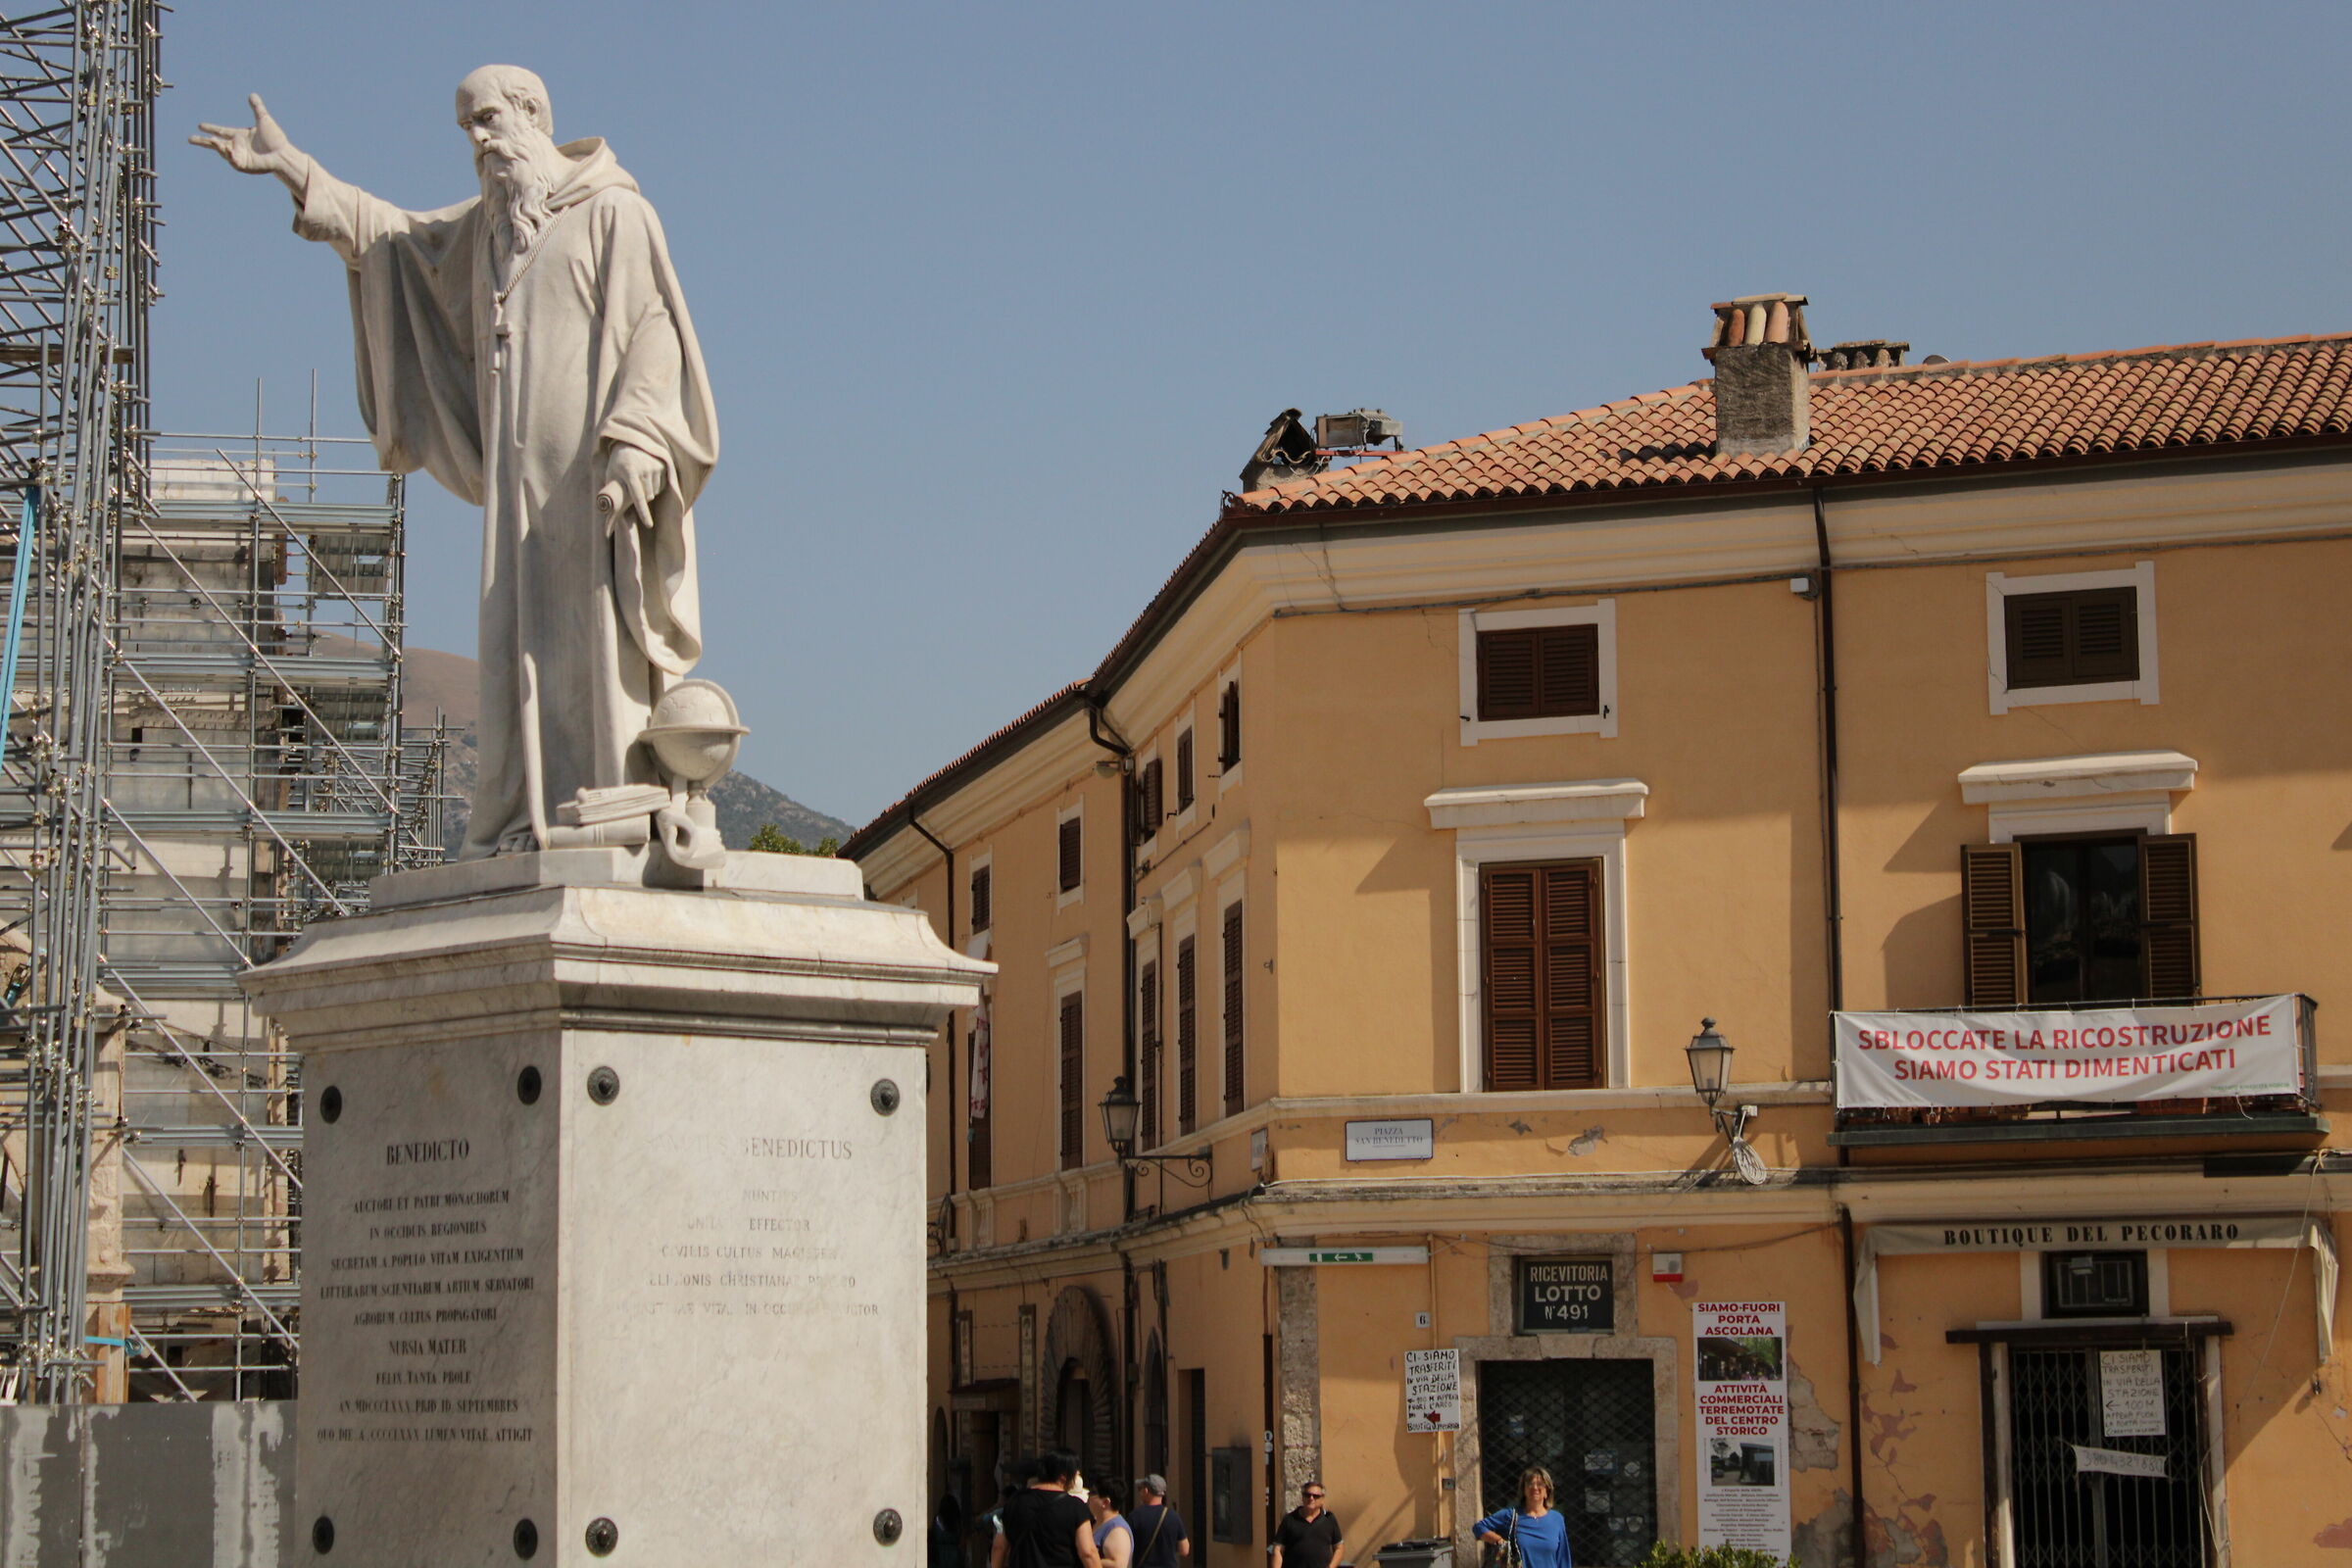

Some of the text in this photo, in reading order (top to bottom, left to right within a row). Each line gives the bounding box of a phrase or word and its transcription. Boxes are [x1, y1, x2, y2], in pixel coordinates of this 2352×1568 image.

[1857, 1014, 2272, 1052] SBLOCCATE LA RICOSTRUZIONE
[1893, 1048, 2235, 1081] SIAMO STATI DIMENTICATI
[1374, 1127, 1403, 1136] PIAZZA
[1355, 1136, 1424, 1146] SAN BENEDETTO
[386, 1138, 469, 1165] BENEDICTO
[353, 1189, 510, 1214] AUCTORI ET PATRI MONACHORUM
[1943, 1223, 2239, 1248] BOUTIQUE DEL PECORARO
[662, 1246, 710, 1258] CVILIS
[716, 1246, 761, 1259] CULTUS
[330, 1254, 377, 1272] SECRETAM
[430, 1250, 460, 1265] VITAM
[720, 1273, 795, 1287] CHRISTIANA
[1530, 1264, 1608, 1283] RICEVITORIA
[484, 1276, 534, 1292] SERVATORI
[1535, 1284, 1601, 1302] LOTTO
[1556, 1303, 1589, 1320] 491
[1697, 1302, 1781, 1312] SIAMO FUORI
[1718, 1314, 1760, 1324] PORTA
[1705, 1326, 1774, 1336] ASCOLANA
[428, 1338, 466, 1355] MATER
[1424, 1349, 1455, 1361] SIAMO
[2101, 1353, 2115, 1366] CI
[442, 1370, 471, 1385] PROLE
[1412, 1382, 1458, 1396] STAZIONE
[1699, 1395, 1783, 1404] COMMERCIALI
[1698, 1404, 1785, 1414] TERREMOTATE
[1705, 1415, 1779, 1425] DEL CENTRO
[1716, 1426, 1768, 1436] STORICO
